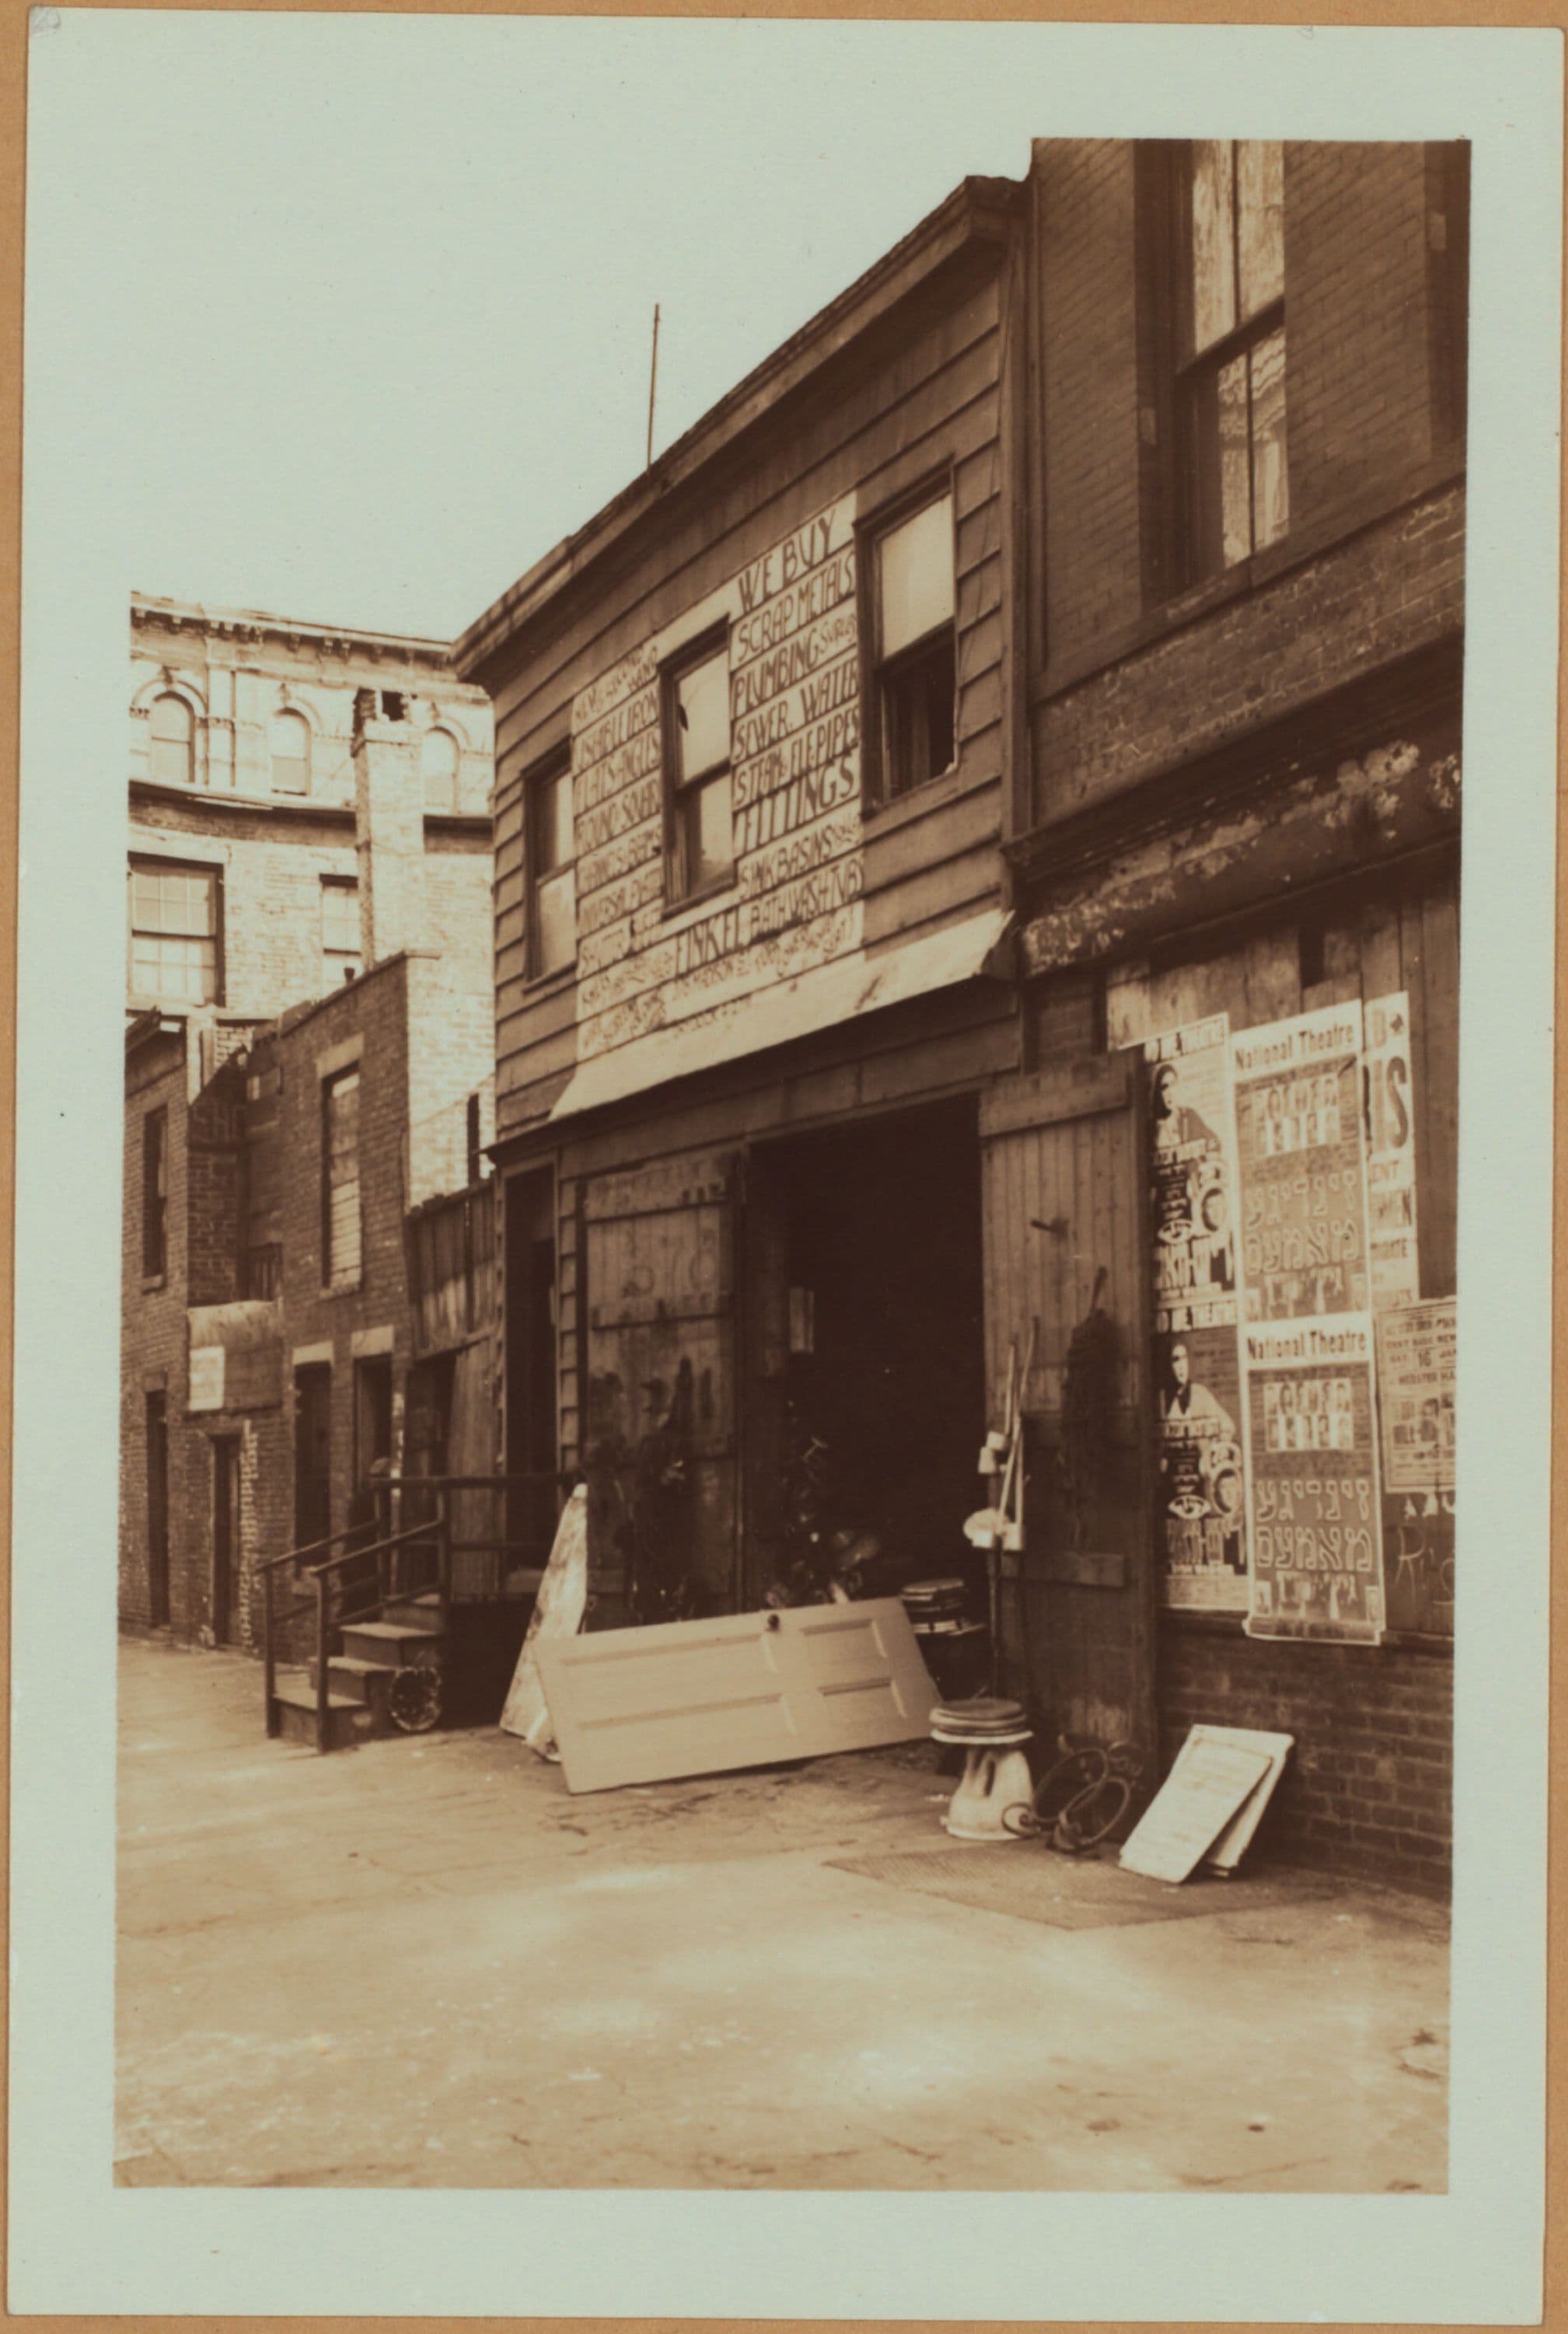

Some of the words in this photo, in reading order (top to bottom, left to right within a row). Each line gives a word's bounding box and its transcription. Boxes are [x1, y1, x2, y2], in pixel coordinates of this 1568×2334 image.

[738, 554, 774, 613] WE
[782, 509, 836, 590] BUY
[738, 595, 794, 662] SCRAP
[798, 552, 856, 619] METALS
[734, 628, 819, 715] PLUMBING
[801, 665, 857, 721] WATER
[735, 751, 854, 854] FITTINGS
[677, 907, 739, 980] FINKEL
[1235, 1037, 1294, 1071] National
[1299, 1023, 1354, 1055] Theatre
[1248, 1332, 1305, 1361] National
[1310, 1329, 1366, 1356] Theatre
